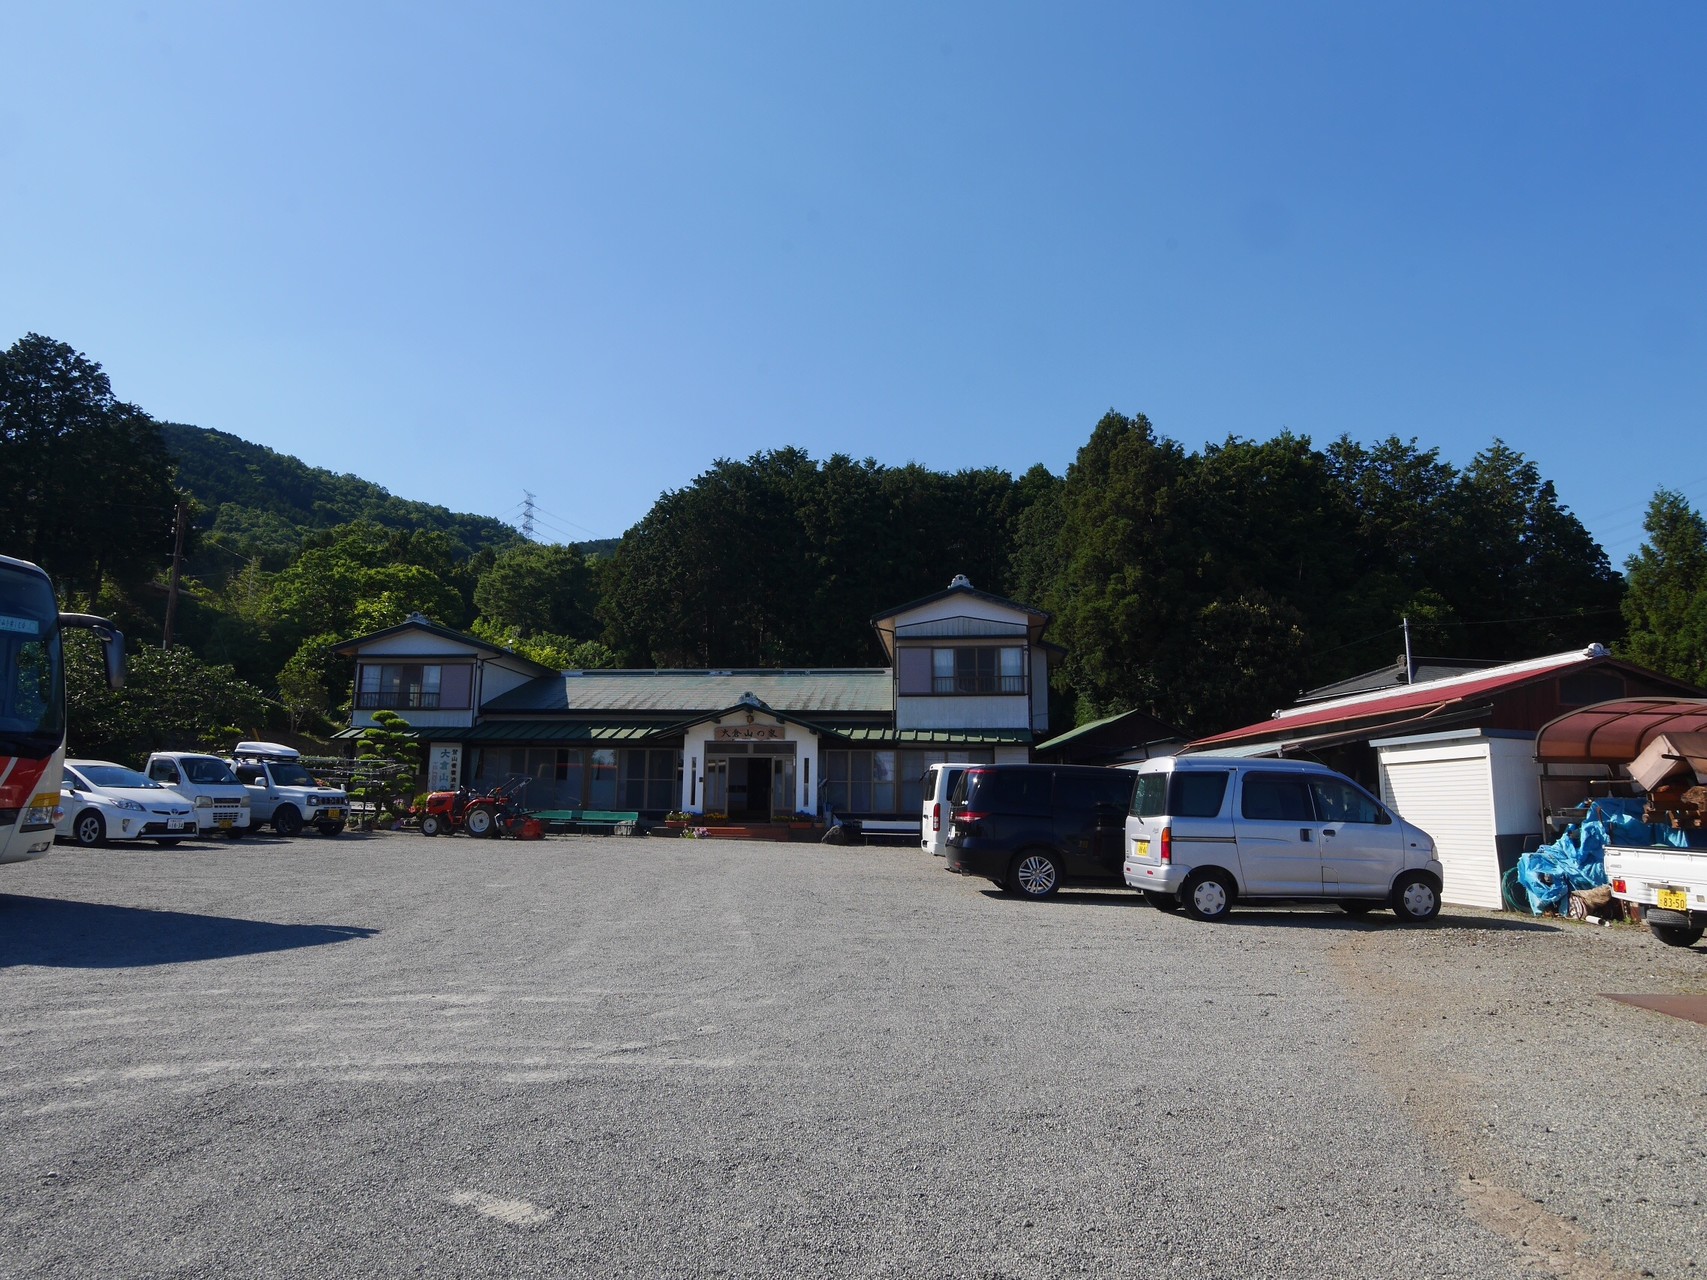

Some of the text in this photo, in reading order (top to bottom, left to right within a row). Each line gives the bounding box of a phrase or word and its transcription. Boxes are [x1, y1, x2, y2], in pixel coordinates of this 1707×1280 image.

[720, 728, 778, 738] 大倉山の家
[1663, 897, 1685, 909] 83-50
